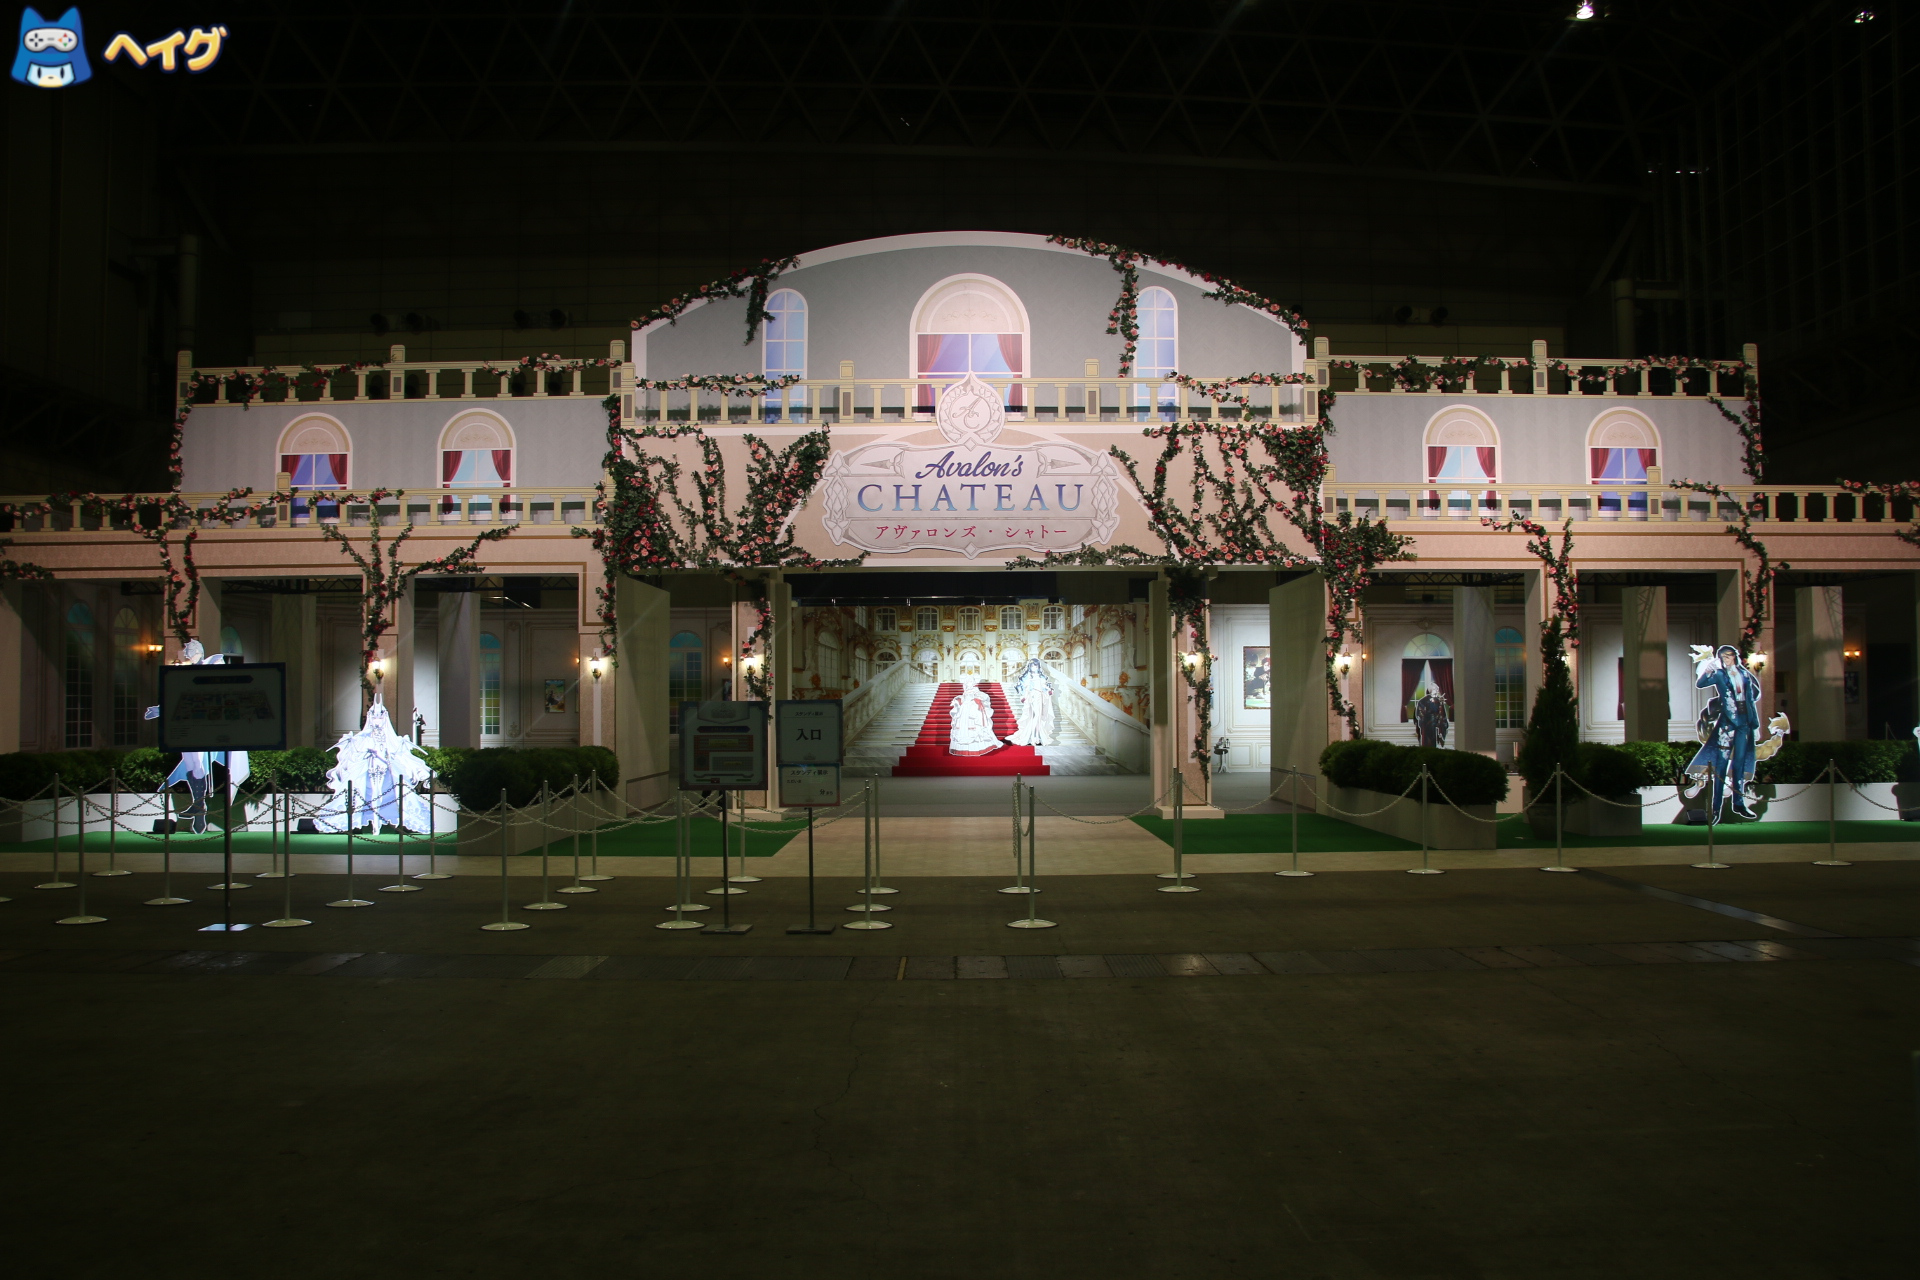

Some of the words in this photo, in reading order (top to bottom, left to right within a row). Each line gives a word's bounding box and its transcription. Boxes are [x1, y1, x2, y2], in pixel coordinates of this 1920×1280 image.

[915, 450, 1024, 479] Avalon's
[857, 483, 1084, 512] CHATEAU
[874, 524, 1068, 541] アヴァロンズ・シャトー
[796, 728, 822, 741] 入口
